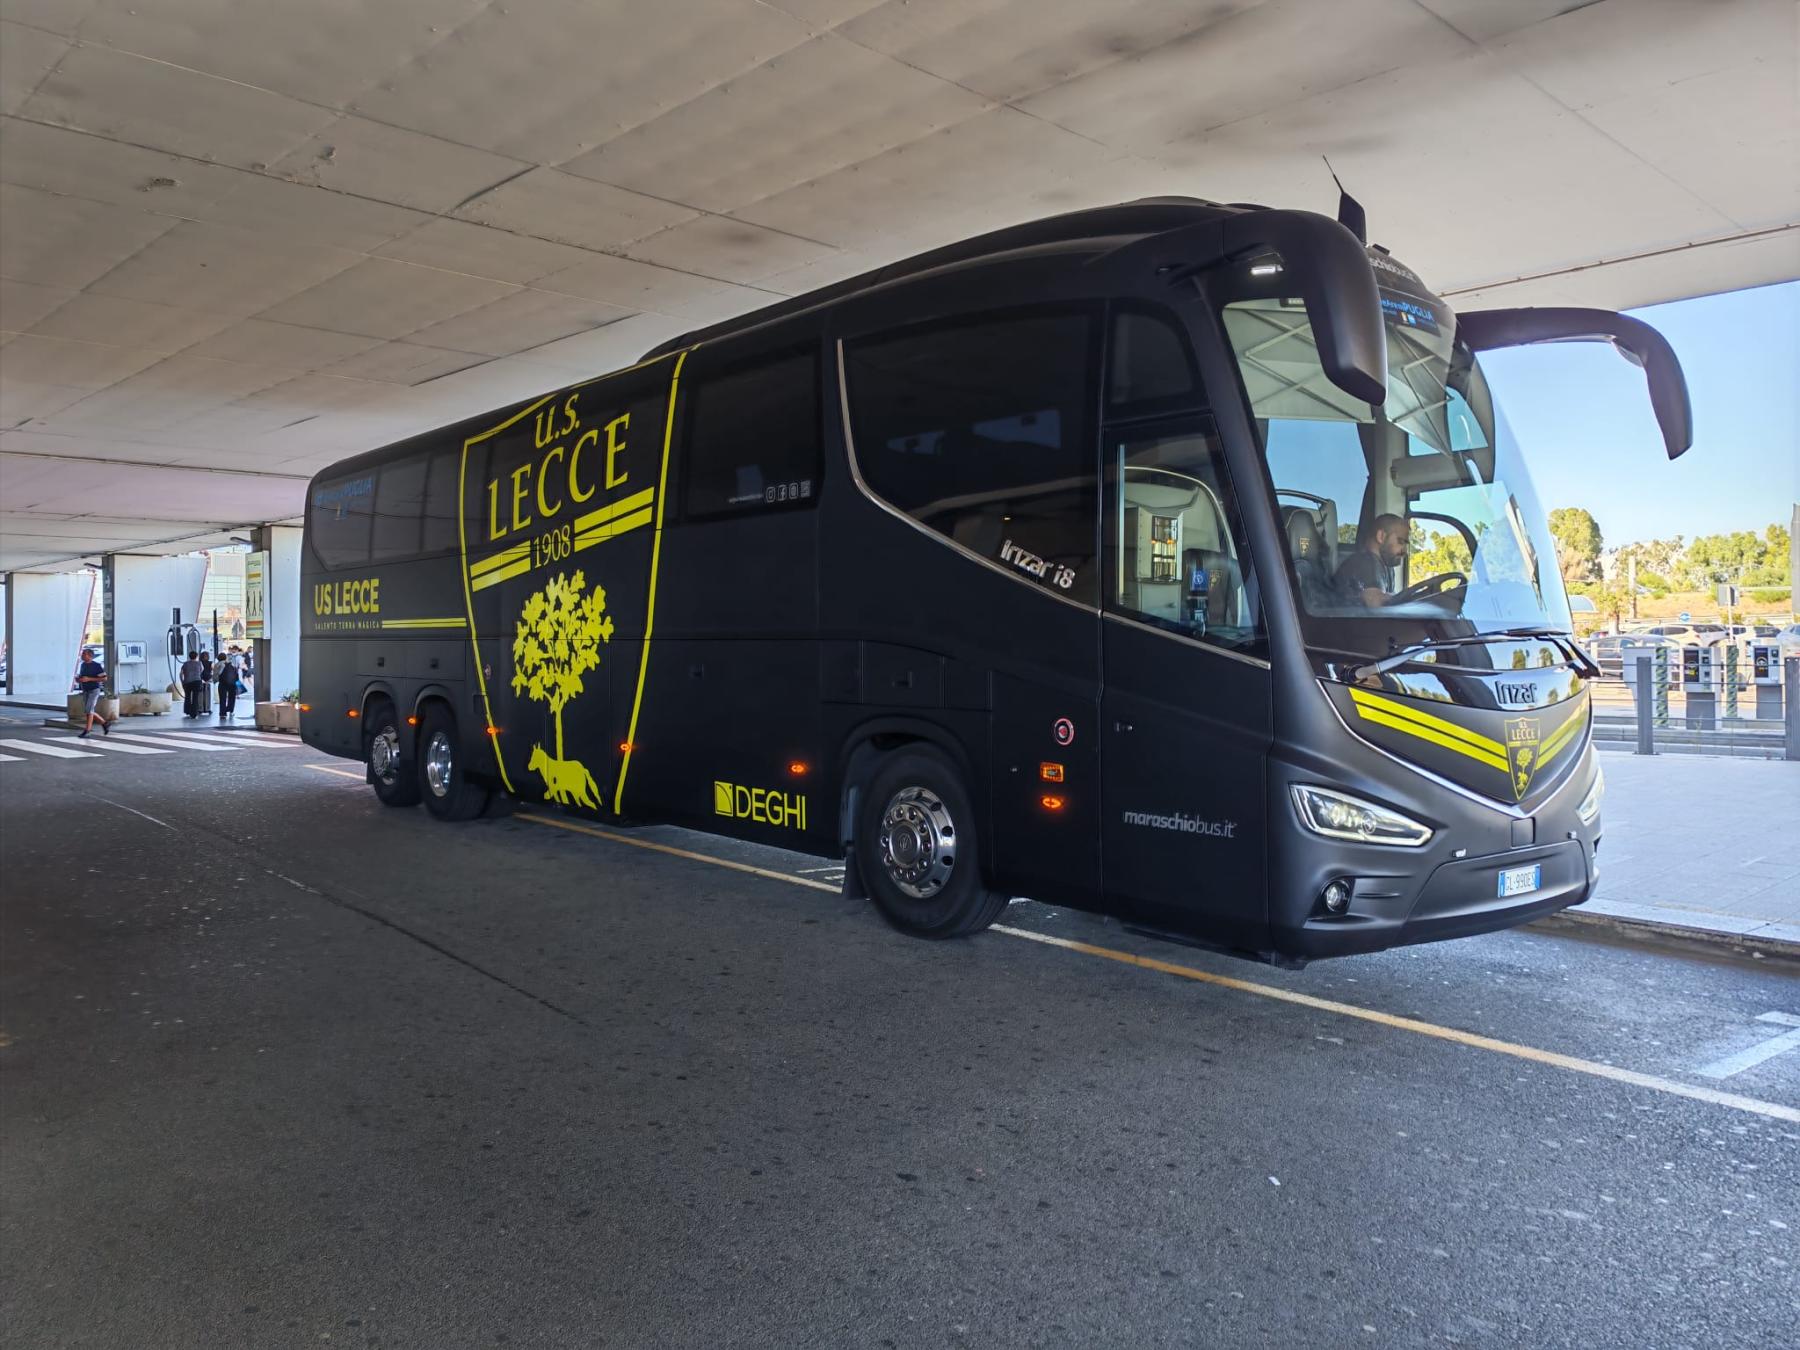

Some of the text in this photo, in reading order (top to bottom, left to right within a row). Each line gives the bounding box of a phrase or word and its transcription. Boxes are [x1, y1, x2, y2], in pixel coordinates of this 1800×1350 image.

[535, 393, 580, 449] U.S.
[488, 413, 630, 541] LECCE
[533, 524, 571, 568] 1908
[315, 578, 380, 615] US LECCE
[1053, 564, 1075, 589] i8
[1511, 728, 1536, 740] LECCE
[736, 785, 806, 830] DEGHI
[1124, 811, 1236, 838] maraschiobus.it
